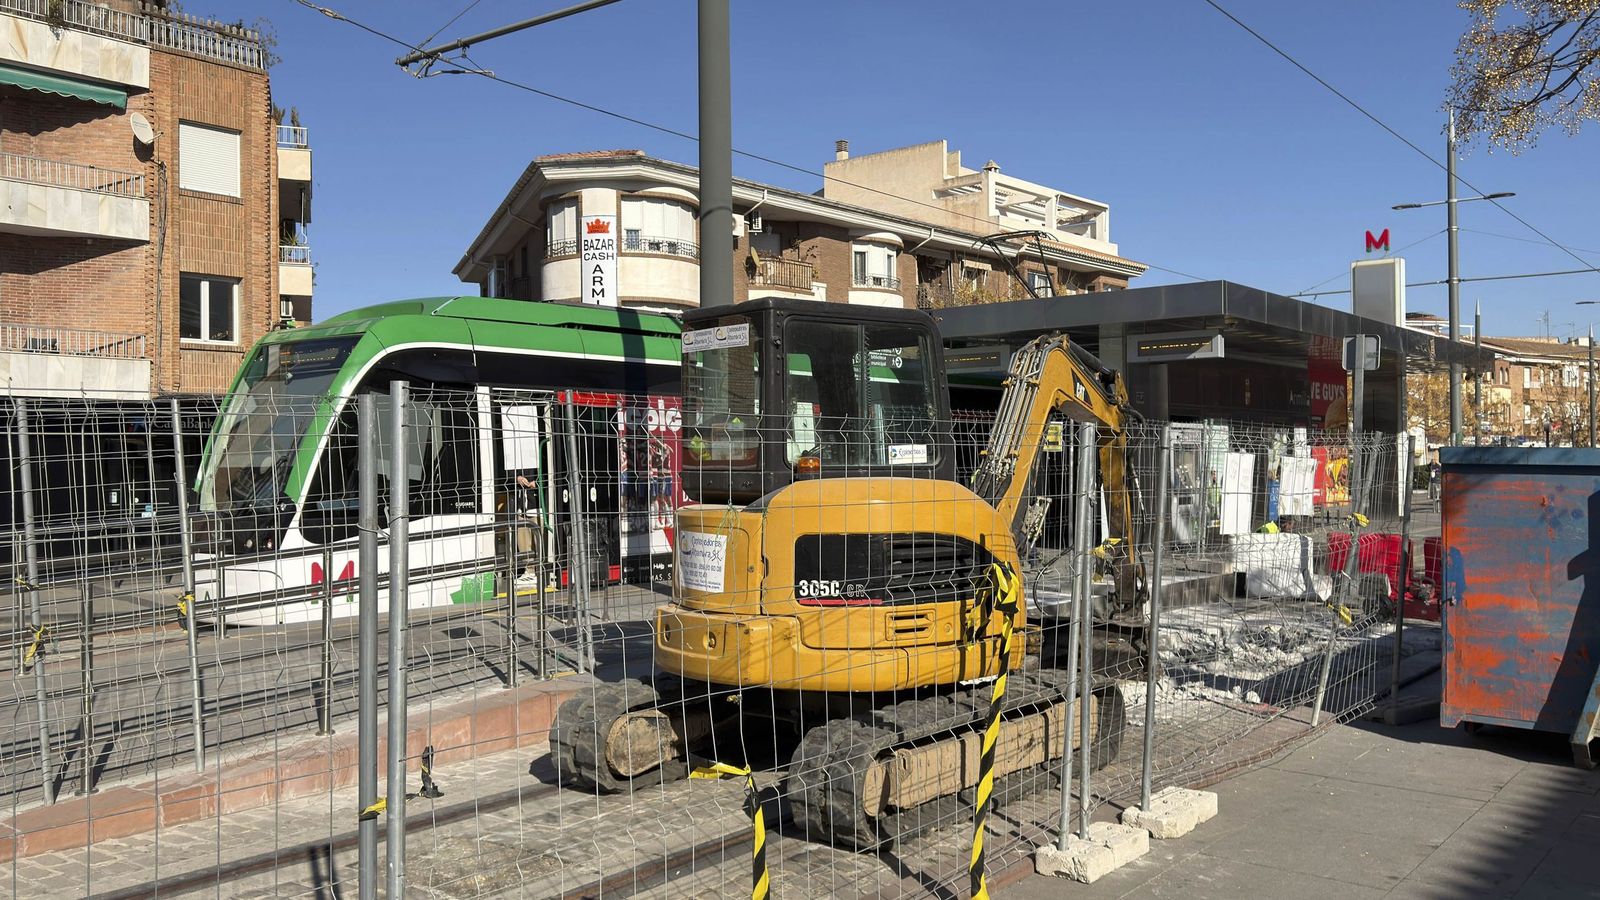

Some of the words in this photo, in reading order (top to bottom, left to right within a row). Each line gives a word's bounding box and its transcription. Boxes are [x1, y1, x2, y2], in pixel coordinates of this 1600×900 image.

[583, 239, 614, 251] BAZAR
[1365, 229, 1389, 253] M
[583, 252, 615, 261] CASH
[1322, 383, 1346, 401] GUYS
[799, 579, 840, 597] 305C
